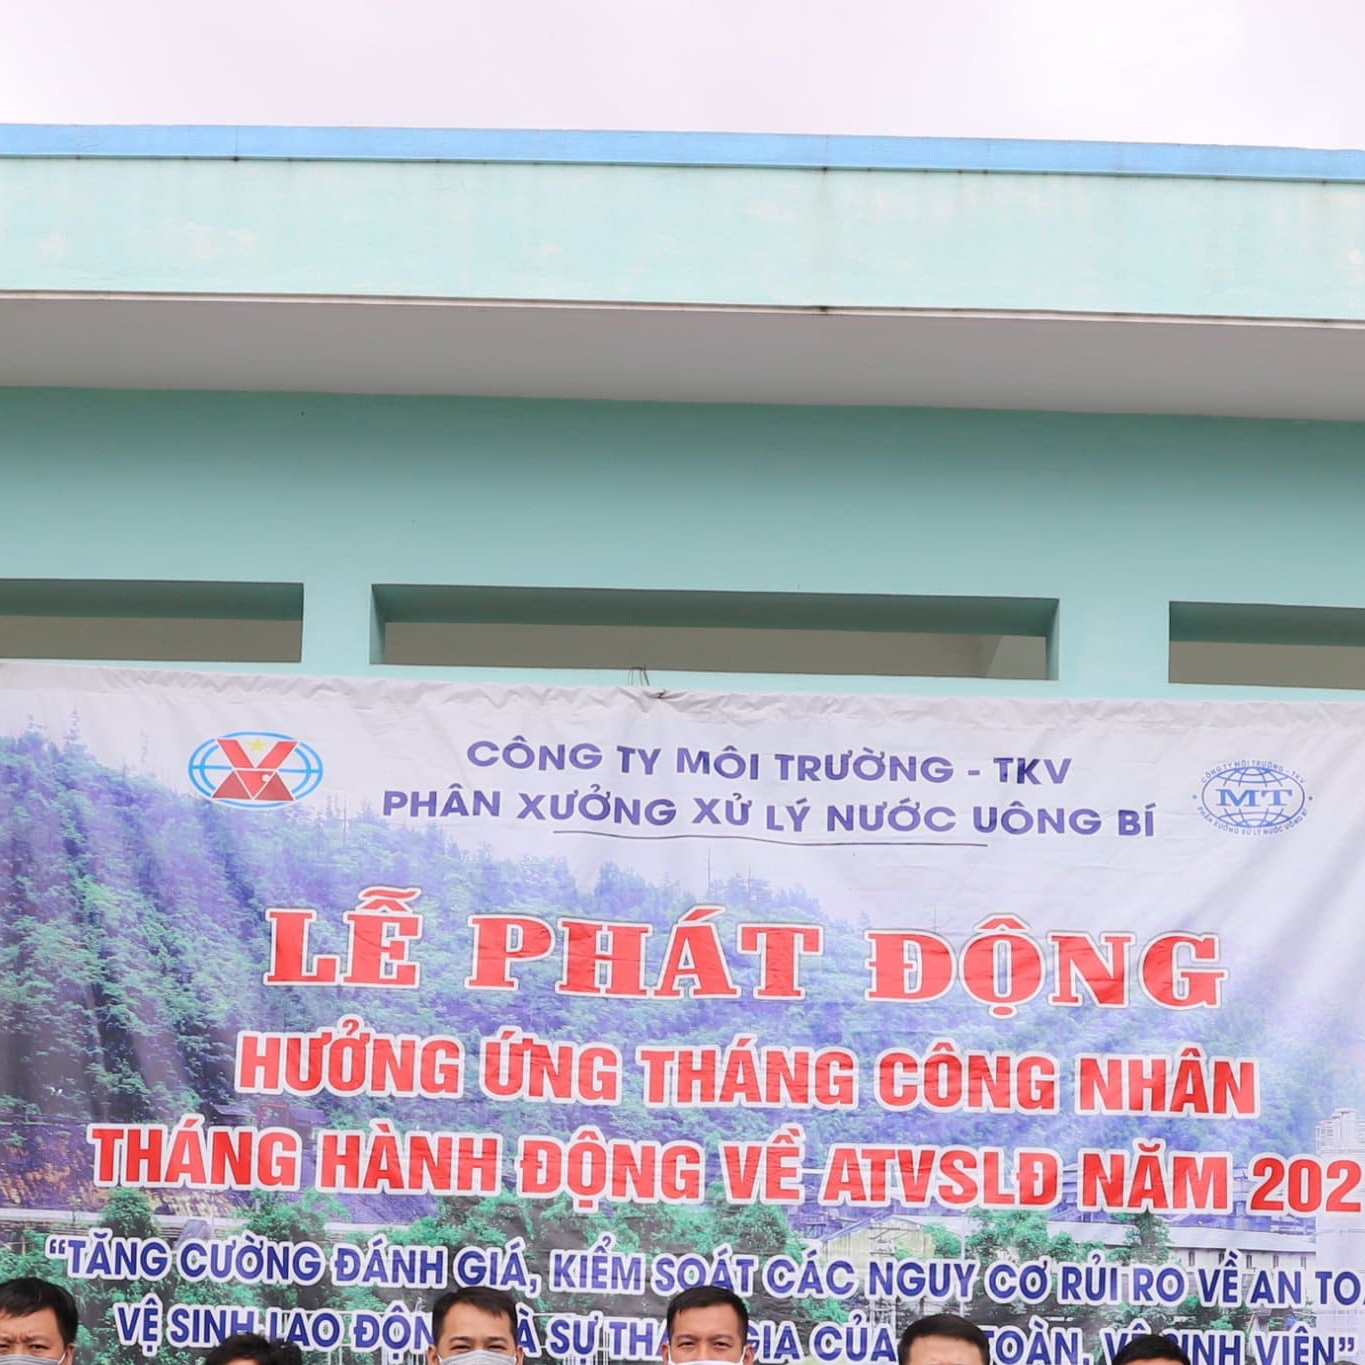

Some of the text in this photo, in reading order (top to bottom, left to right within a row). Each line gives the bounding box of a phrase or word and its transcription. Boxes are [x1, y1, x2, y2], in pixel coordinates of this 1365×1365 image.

[467, 735, 602, 771] CÔNG
[617, 745, 661, 775] TY
[676, 745, 758, 780] MÔI
[775, 747, 954, 783] TRƯỜNG
[993, 757, 1071, 785] TKV
[383, 783, 1157, 837] PHÂN XƯỞNG XỬ LÝ NƯỚC UÔNG BÍ
[1215, 788, 1293, 808] MT
[265, 887, 1226, 1018] LỄ PHÁT ĐỘNG
[238, 1018, 1257, 1115] HƯỞNG ỨNG THÁNG CÔNG NHÂN
[91, 1118, 299, 1187] THÁNG
[321, 1122, 499, 1193] HÀNH
[521, 1130, 703, 1209] ĐỘNG
[724, 1128, 802, 1200] VỀ
[823, 1145, 1059, 1206] ATVSLĐ
[1081, 1142, 1228, 1211] NĂM
[180, 1235, 322, 1282] CƯỜNG
[335, 1238, 445, 1284] ĐÁNH
[458, 1240, 537, 1292] GIÁ,
[553, 1236, 643, 1291] KIỂM
[655, 1247, 755, 1292] SOÁT
[766, 1249, 856, 1296] CÁC
[869, 1261, 977, 1299] NGUY
[988, 1258, 1049, 1300] CƠ
[1061, 1254, 1118, 1300] RỦI
[1134, 1267, 1186, 1302] RO
[1198, 1250, 1240, 1303] VỀ
[1250, 1269, 1302, 1305] AN
[117, 1299, 159, 1353] VỆ
[171, 1308, 255, 1343] SINH
[269, 1312, 341, 1348] LAO
[353, 1304, 435, 1360] ĐỘN
[516, 1308, 538, 1353] À
[550, 1316, 599, 1364] SỰ
[813, 1314, 897, 1362] CỦA
